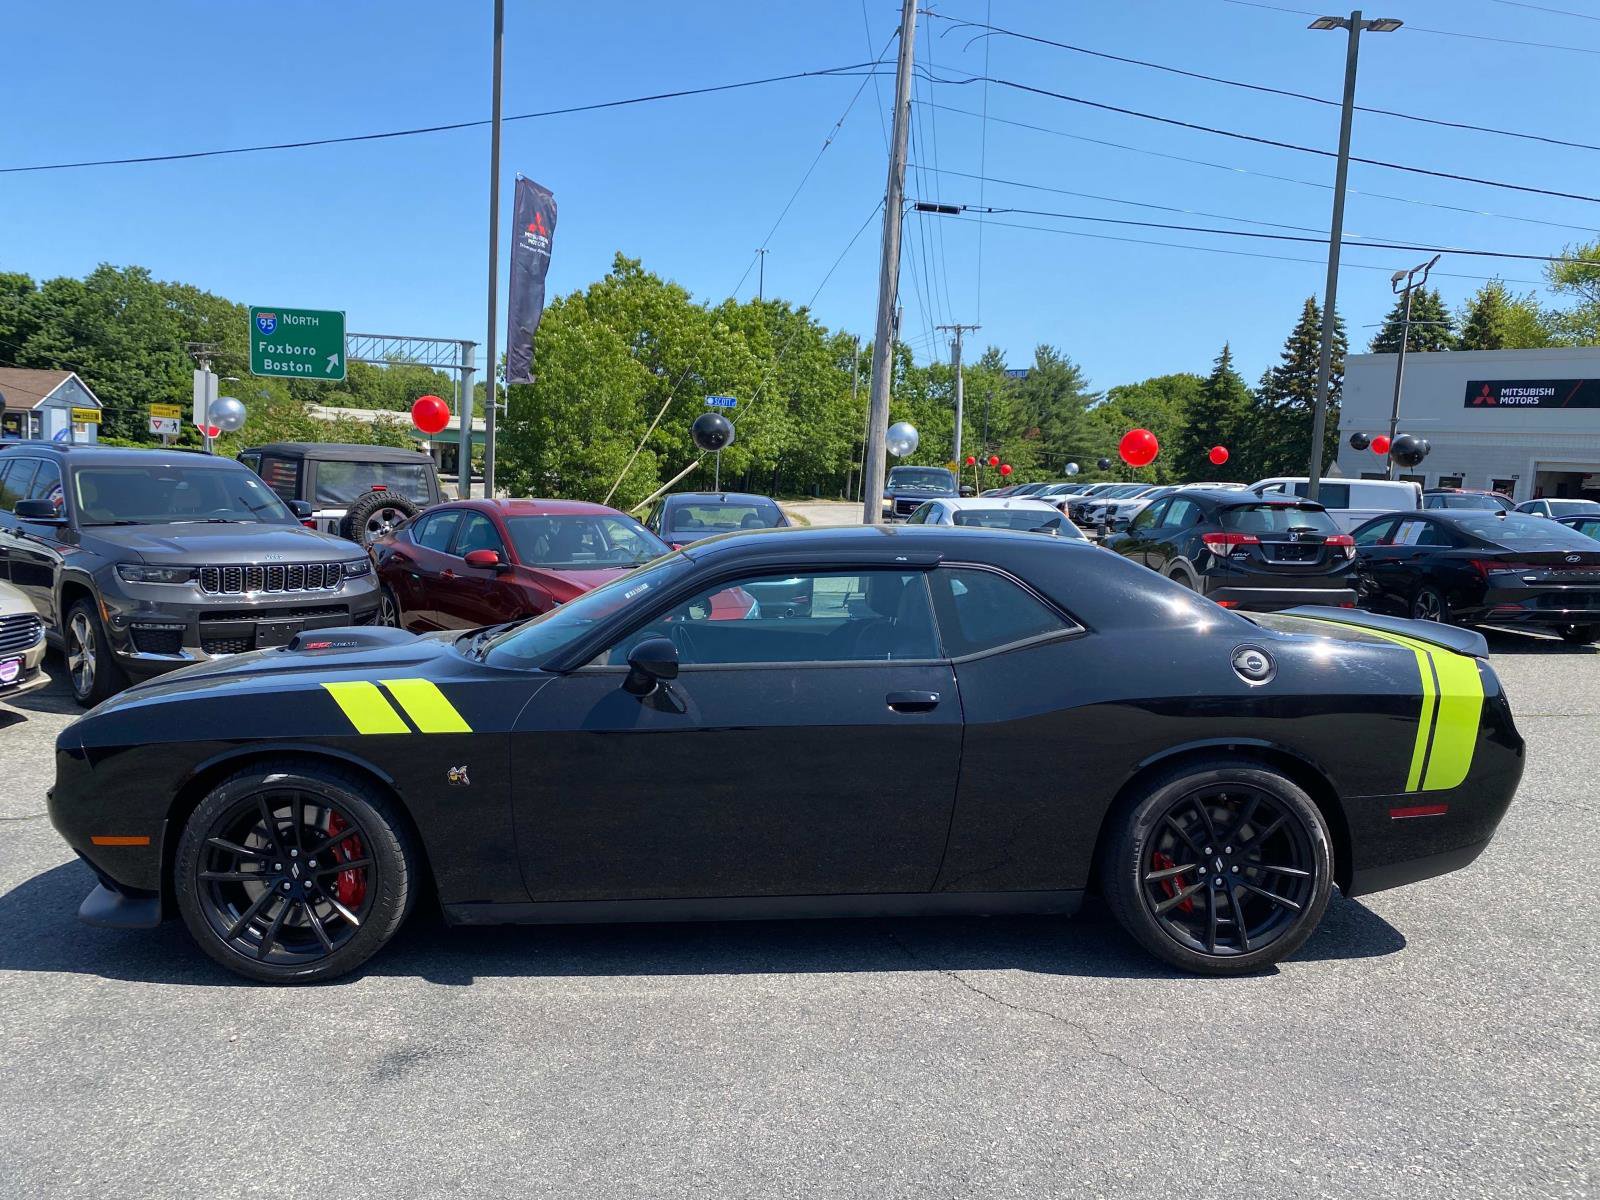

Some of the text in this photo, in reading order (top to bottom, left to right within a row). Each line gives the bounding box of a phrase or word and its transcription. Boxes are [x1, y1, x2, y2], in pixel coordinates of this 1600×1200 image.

[260, 318, 274, 329] 95
[283, 314, 319, 326] NORTH
[259, 342, 316, 355] Foxboro
[264, 359, 312, 373] Boston
[1500, 387, 1555, 396] MITSUBISHI
[714, 397, 731, 406] SCOTT
[1499, 396, 1540, 405] MOTORS
